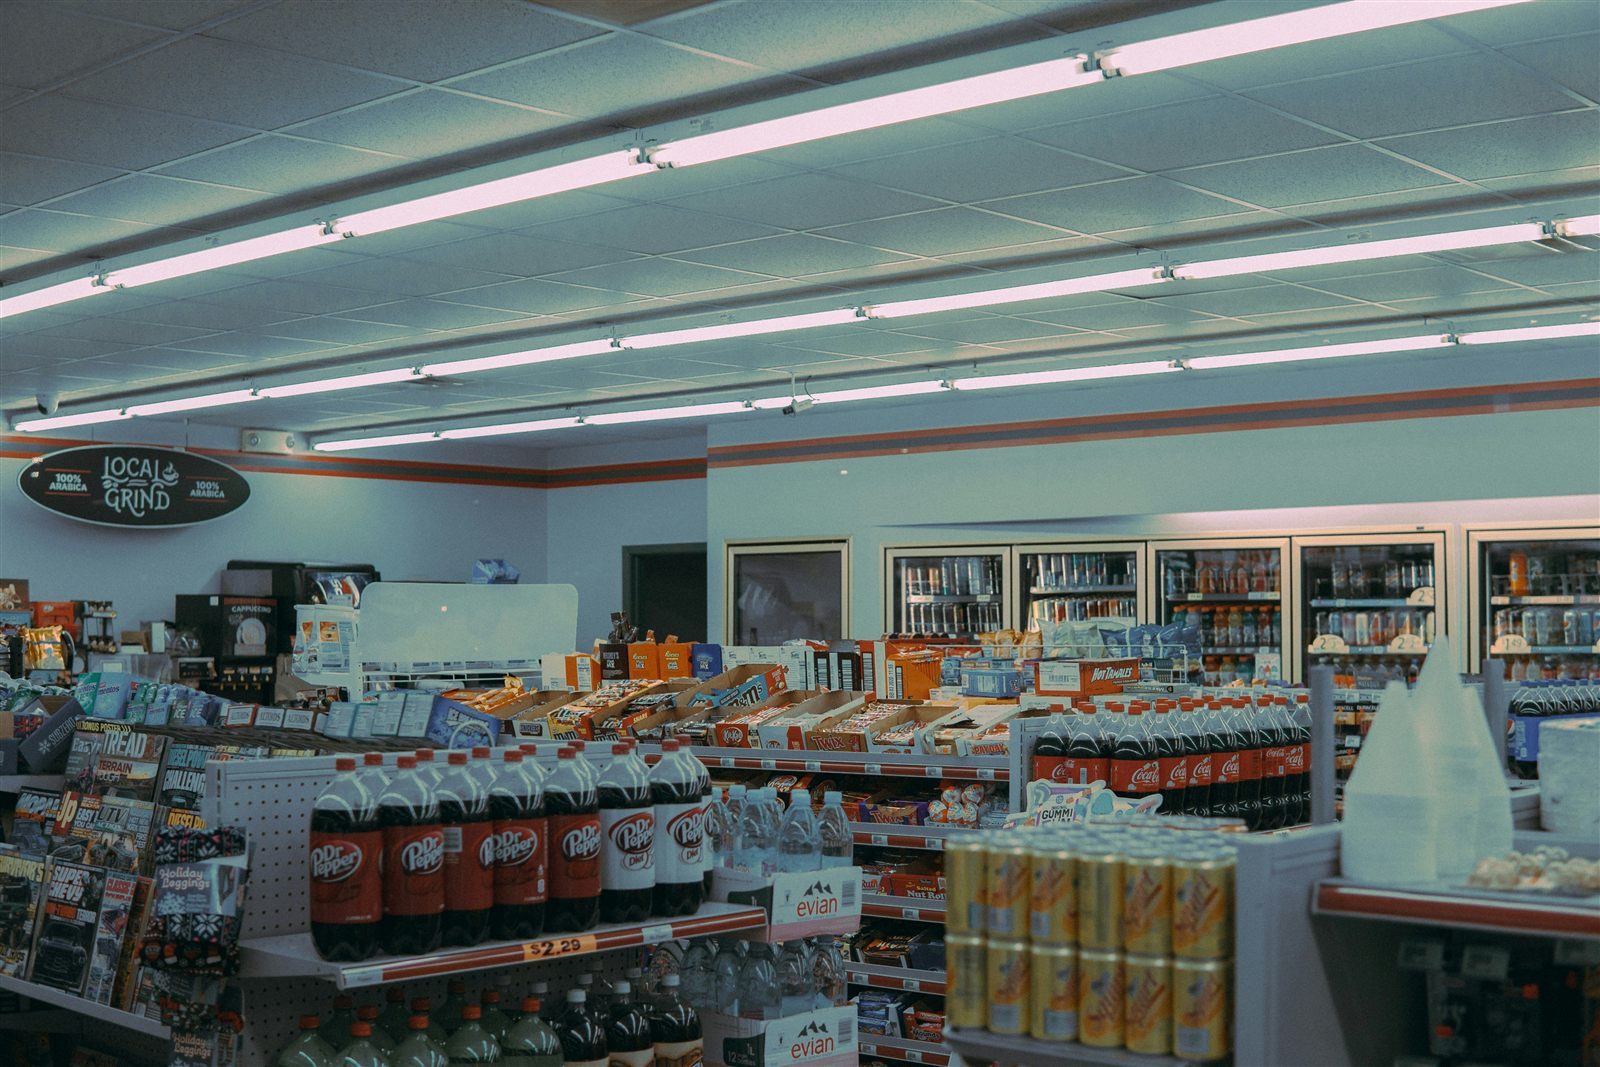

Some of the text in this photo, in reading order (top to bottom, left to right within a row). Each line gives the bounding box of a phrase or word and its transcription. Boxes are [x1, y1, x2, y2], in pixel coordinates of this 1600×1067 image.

[102, 456, 174, 483] LOCAL
[49, 482, 88, 492] ARABICA
[55, 473, 82, 484] 100%
[196, 481, 220, 490] 100%
[105, 483, 171, 517] GRIND
[190, 489, 225, 498] ARABICA
[232, 605, 272, 614] CAPPUCCINO
[1091, 666, 1133, 683] HOT TAMALES
[99, 684, 120, 696] mentos
[174, 708, 187, 719] ICE
[190, 707, 203, 718] ICE
[260, 711, 281, 722] ALTOIDS
[287, 712, 309, 723] ALTOIDS
[520, 723, 539, 733] SNICKERS
[103, 731, 148, 758] TREAD
[811, 734, 845, 751] Twix
[99, 760, 133, 774] TERRAIN
[98, 805, 128, 824] UTV
[1041, 809, 1073, 820] GUMMI
[502, 831, 523, 848] Dr
[582, 825, 597, 843] Dr
[323, 844, 345, 861] Dr
[422, 836, 440, 854] Dr
[311, 847, 358, 878] Pepper
[53, 864, 90, 887] SUPER
[158, 867, 203, 883] Holiday
[161, 878, 211, 891] Leggings
[907, 889, 926, 899] Nut
[797, 896, 838, 917] evian
[530, 938, 581, 957] $2.29
[172, 1031, 208, 1048] Holiday
[791, 1037, 834, 1059] evian
[173, 1043, 212, 1060] Leggings
